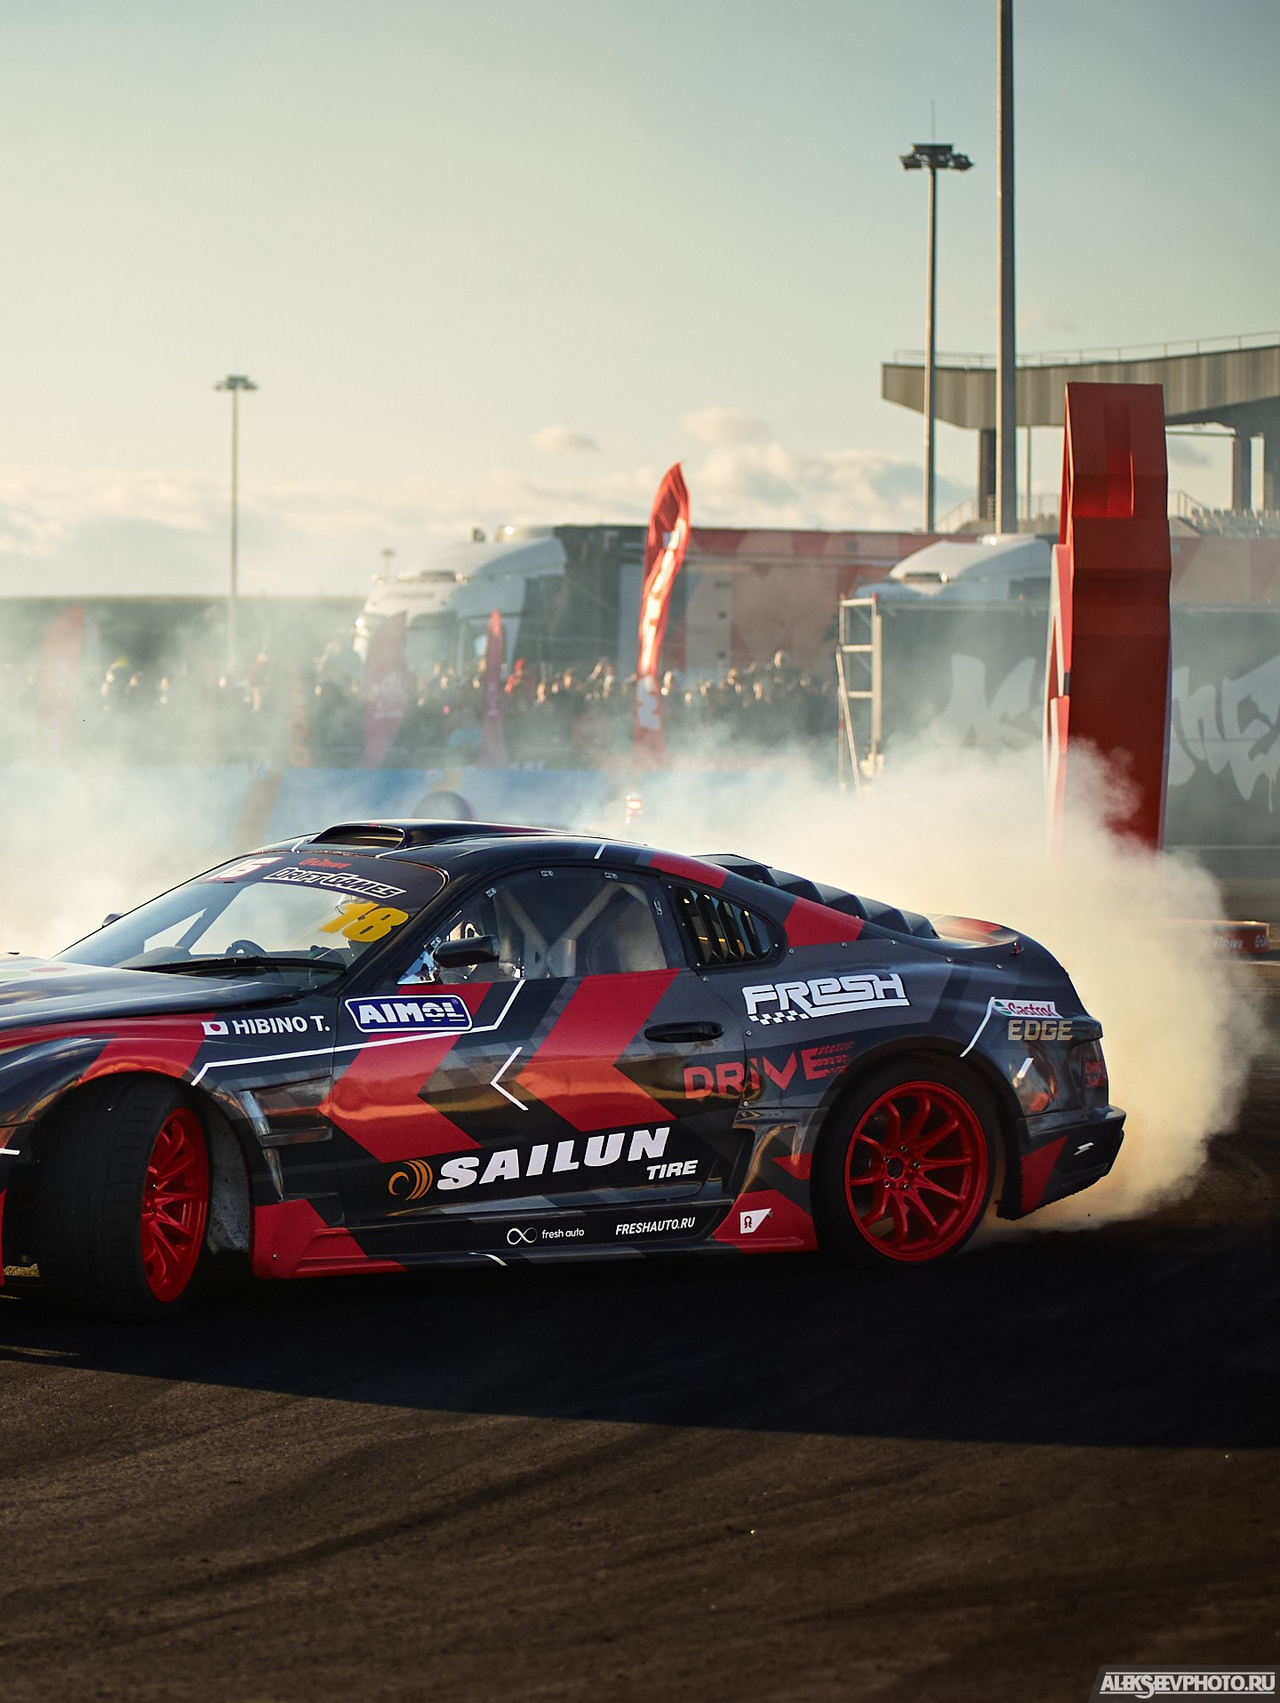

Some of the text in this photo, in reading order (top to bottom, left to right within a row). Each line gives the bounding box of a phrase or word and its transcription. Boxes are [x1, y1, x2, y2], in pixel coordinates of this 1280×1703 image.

[319, 902, 409, 942] 18
[359, 1002, 465, 1024] AIMOL
[1008, 1002, 1059, 1017] Castrol
[233, 1015, 331, 1035] HIBINO T.
[1008, 1020, 1074, 1041] EDGE
[683, 1041, 854, 1099] DRIVE
[437, 1127, 670, 1190] SAILUN
[646, 1159, 699, 1180] TIRE
[541, 1228, 585, 1239] fresh auto
[615, 1217, 695, 1236] FRESHAUTO.RU
